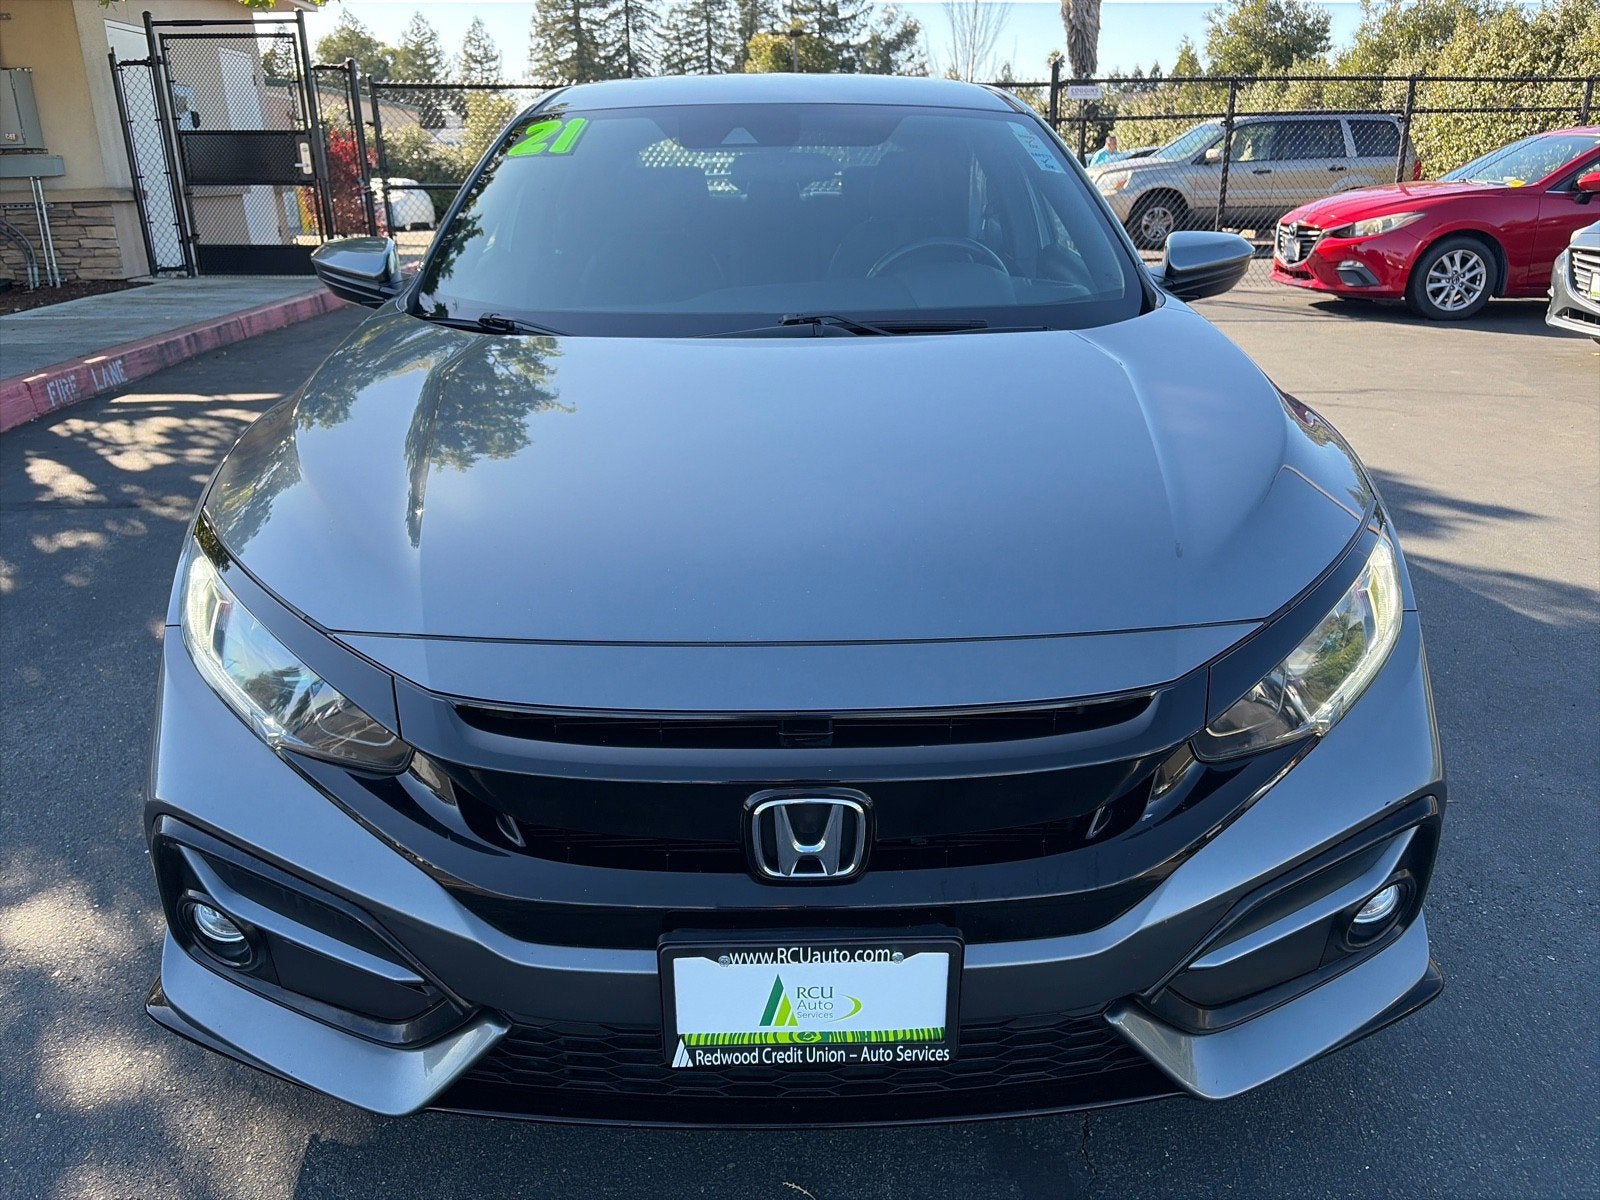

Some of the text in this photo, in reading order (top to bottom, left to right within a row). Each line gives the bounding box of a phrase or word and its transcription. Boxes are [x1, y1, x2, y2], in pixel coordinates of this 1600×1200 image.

[507, 117, 589, 156] 21
[46, 359, 128, 407] FIRE LANE
[729, 947, 891, 965] www.RCUauto.com
[796, 986, 834, 999] RCU
[796, 999, 834, 1011] Auto
[796, 1012, 834, 1020] Services
[695, 1049, 760, 1066] Redwood
[762, 1048, 803, 1064] Credit
[806, 1047, 846, 1064] Union
[861, 1047, 894, 1062] Auto
[896, 1046, 950, 1062] Services
